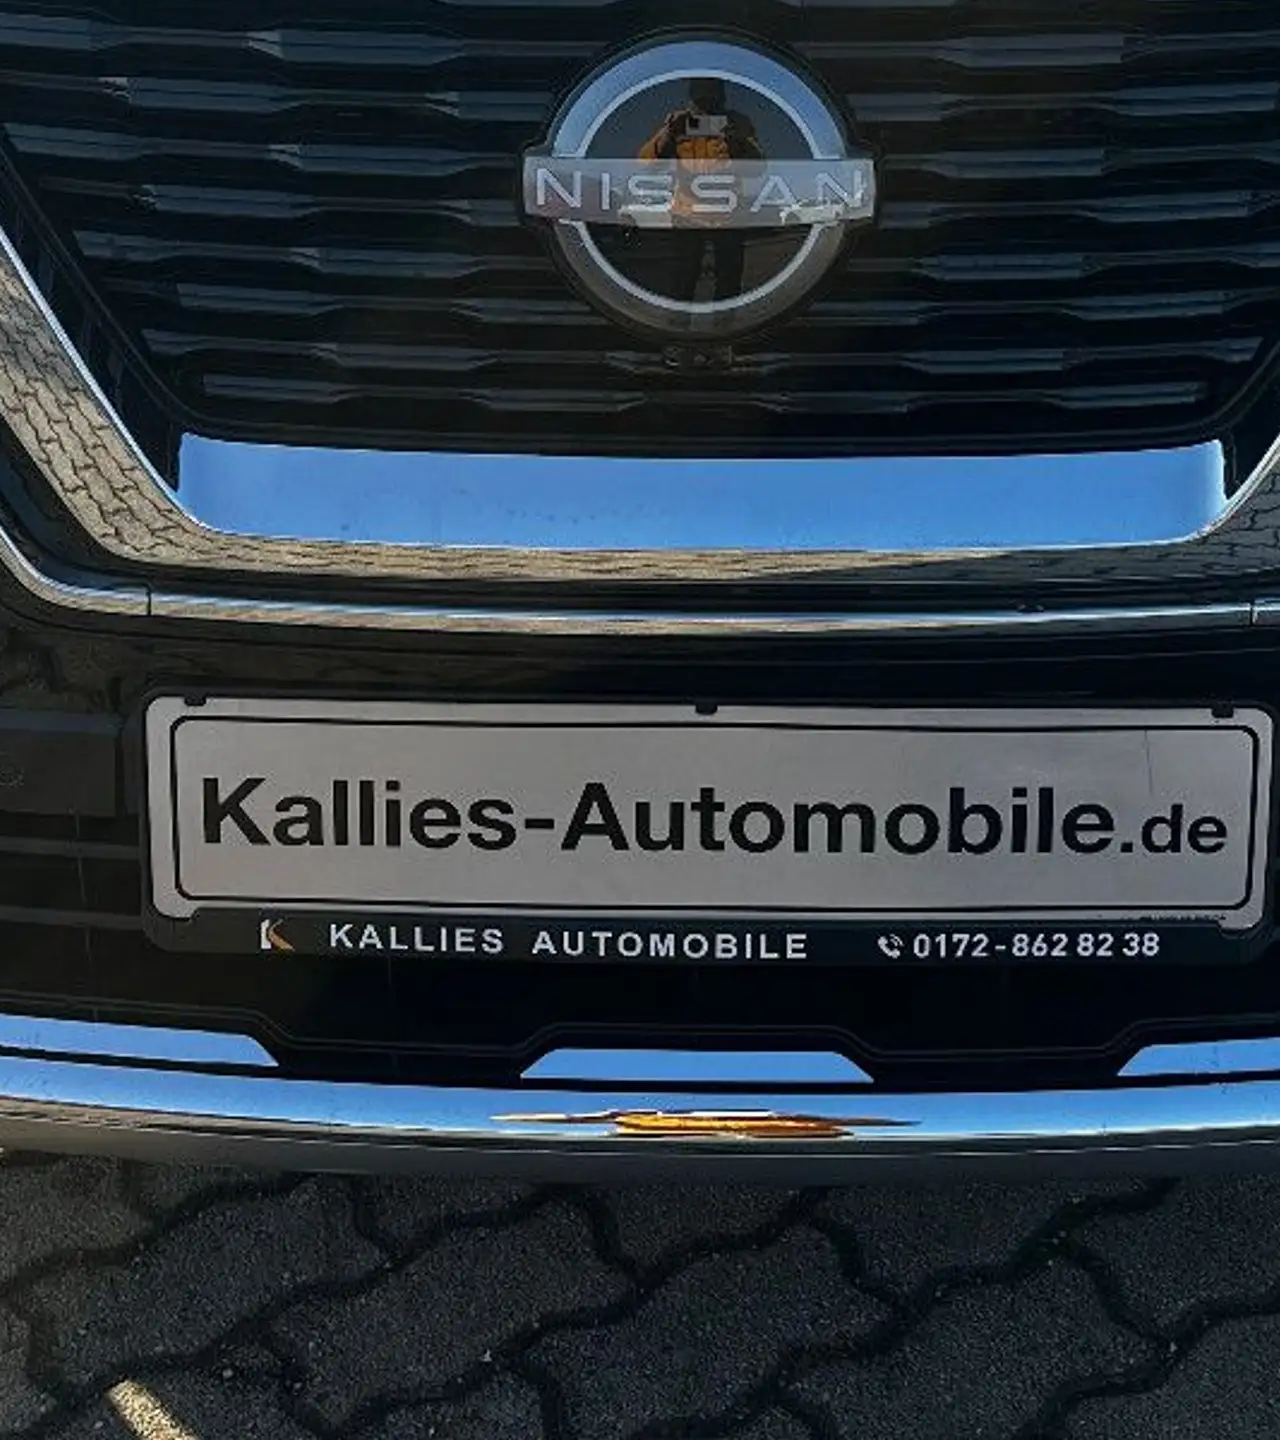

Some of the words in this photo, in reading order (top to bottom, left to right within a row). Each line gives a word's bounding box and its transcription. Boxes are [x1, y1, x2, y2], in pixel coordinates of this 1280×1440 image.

[535, 167, 864, 215] NISSAN
[202, 776, 1228, 856] Kallies-Automobile.de
[329, 922, 504, 954] KALLIES
[530, 929, 808, 959] AUTOMOBILE
